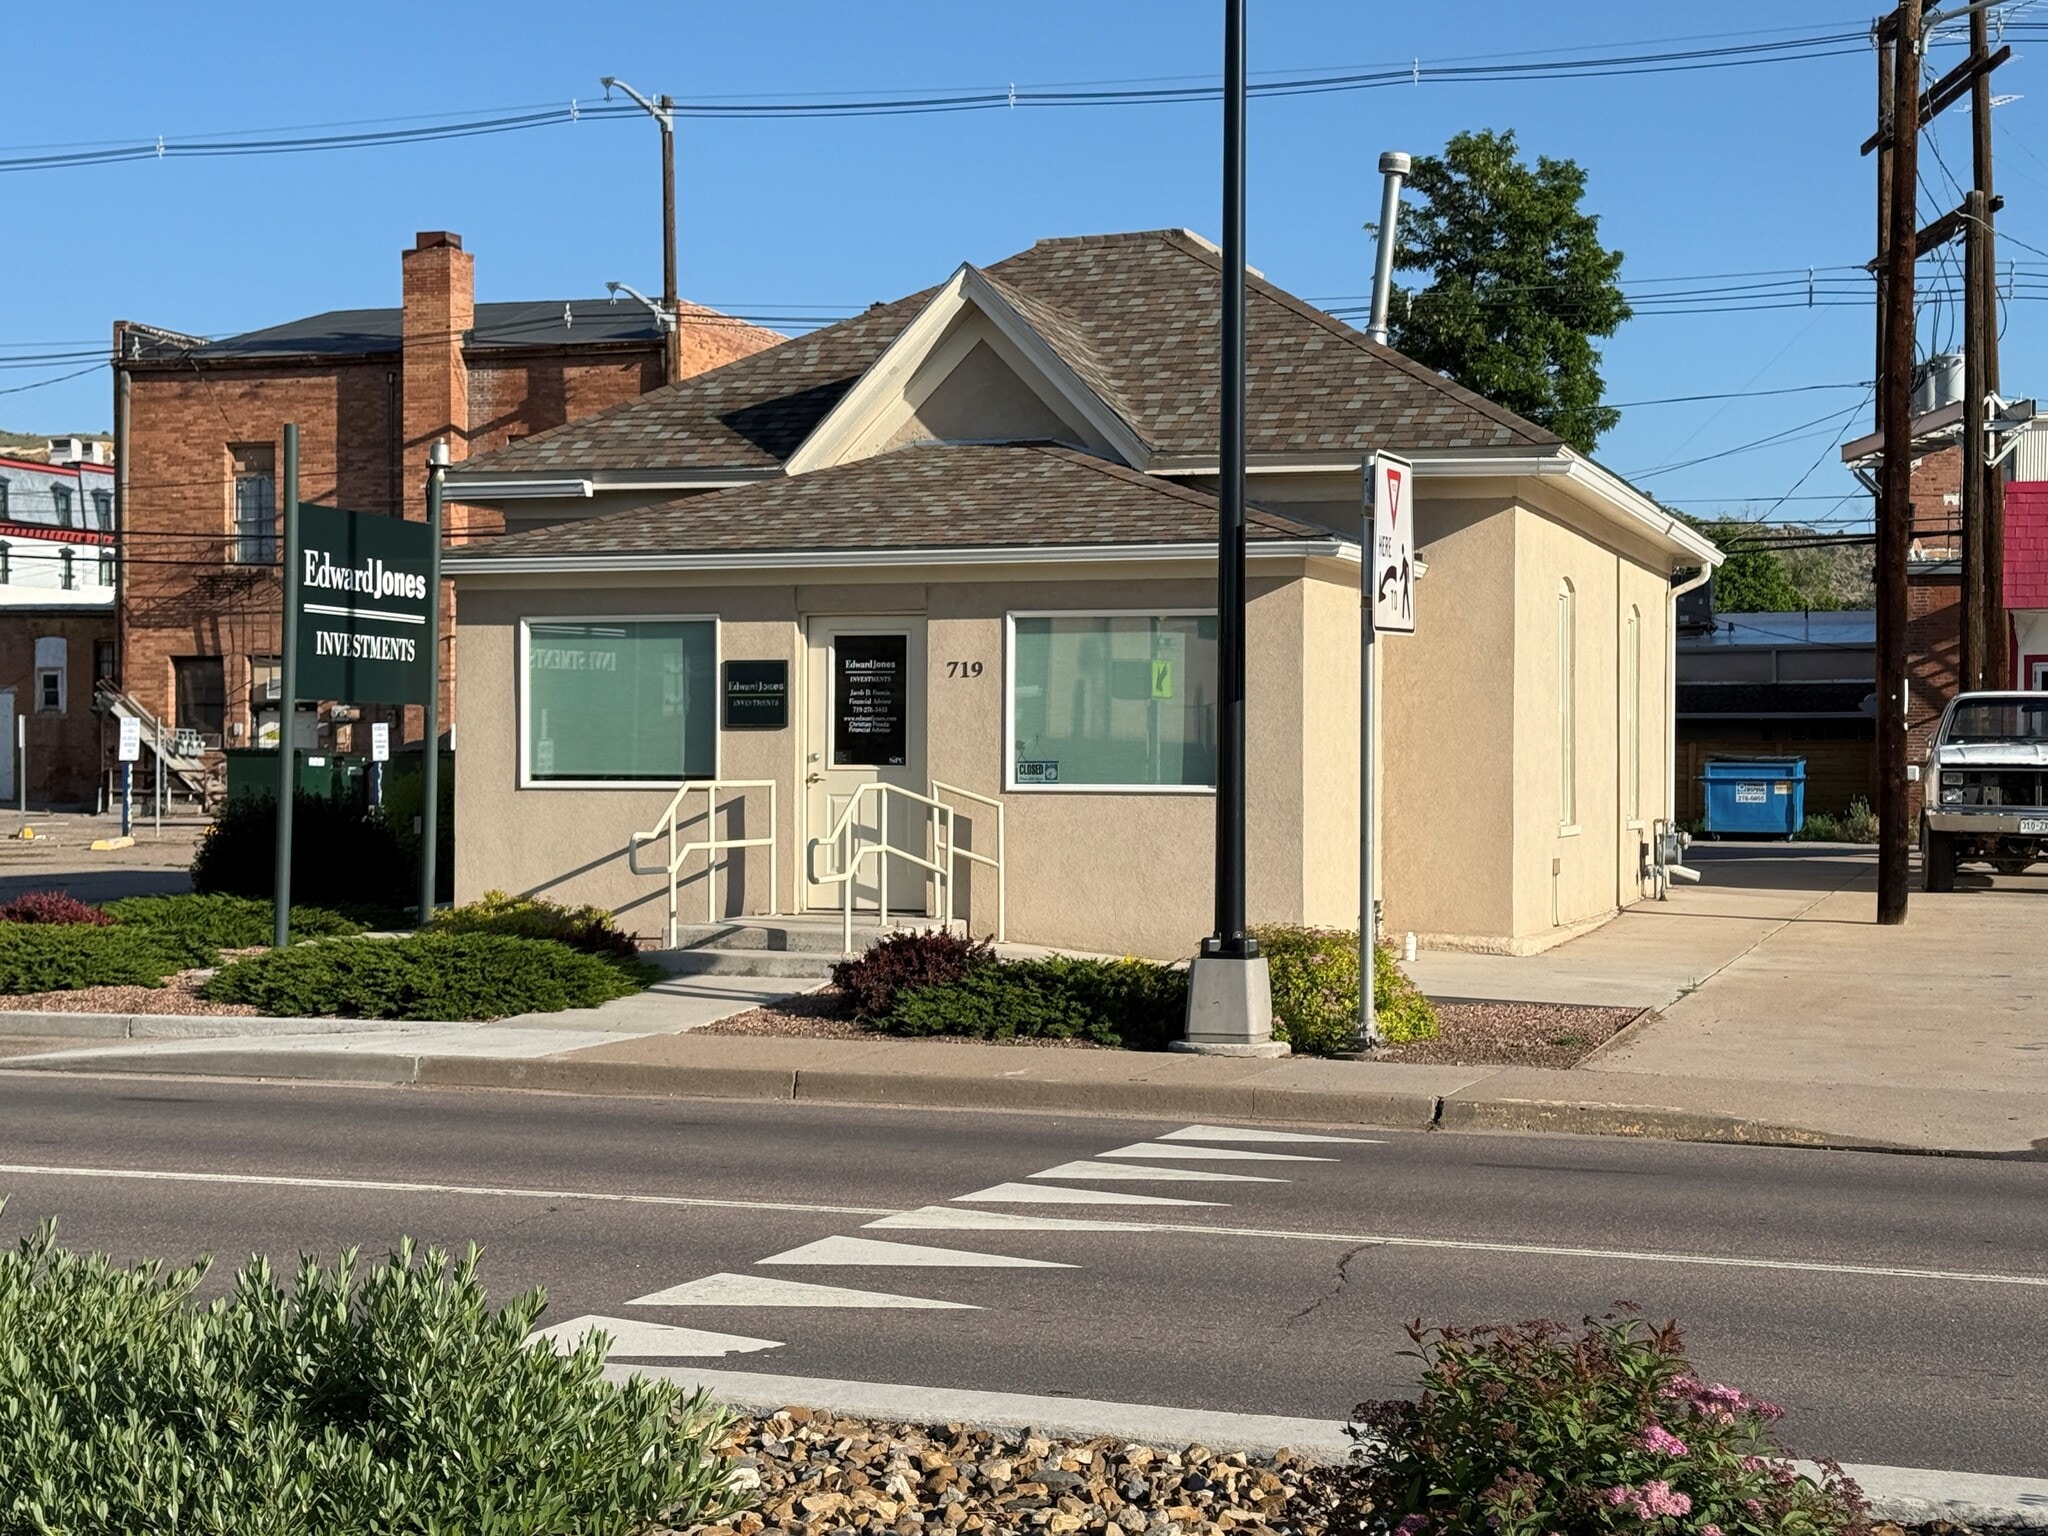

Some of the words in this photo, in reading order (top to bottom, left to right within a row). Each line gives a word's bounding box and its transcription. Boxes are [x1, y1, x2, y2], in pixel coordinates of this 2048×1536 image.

[1378, 534, 1392, 558] HERE
[1390, 589, 1398, 611] TO
[316, 630, 415, 662] INVESTMENTS
[946, 661, 983, 679] 719
[1019, 764, 1044, 776] CLOSED
